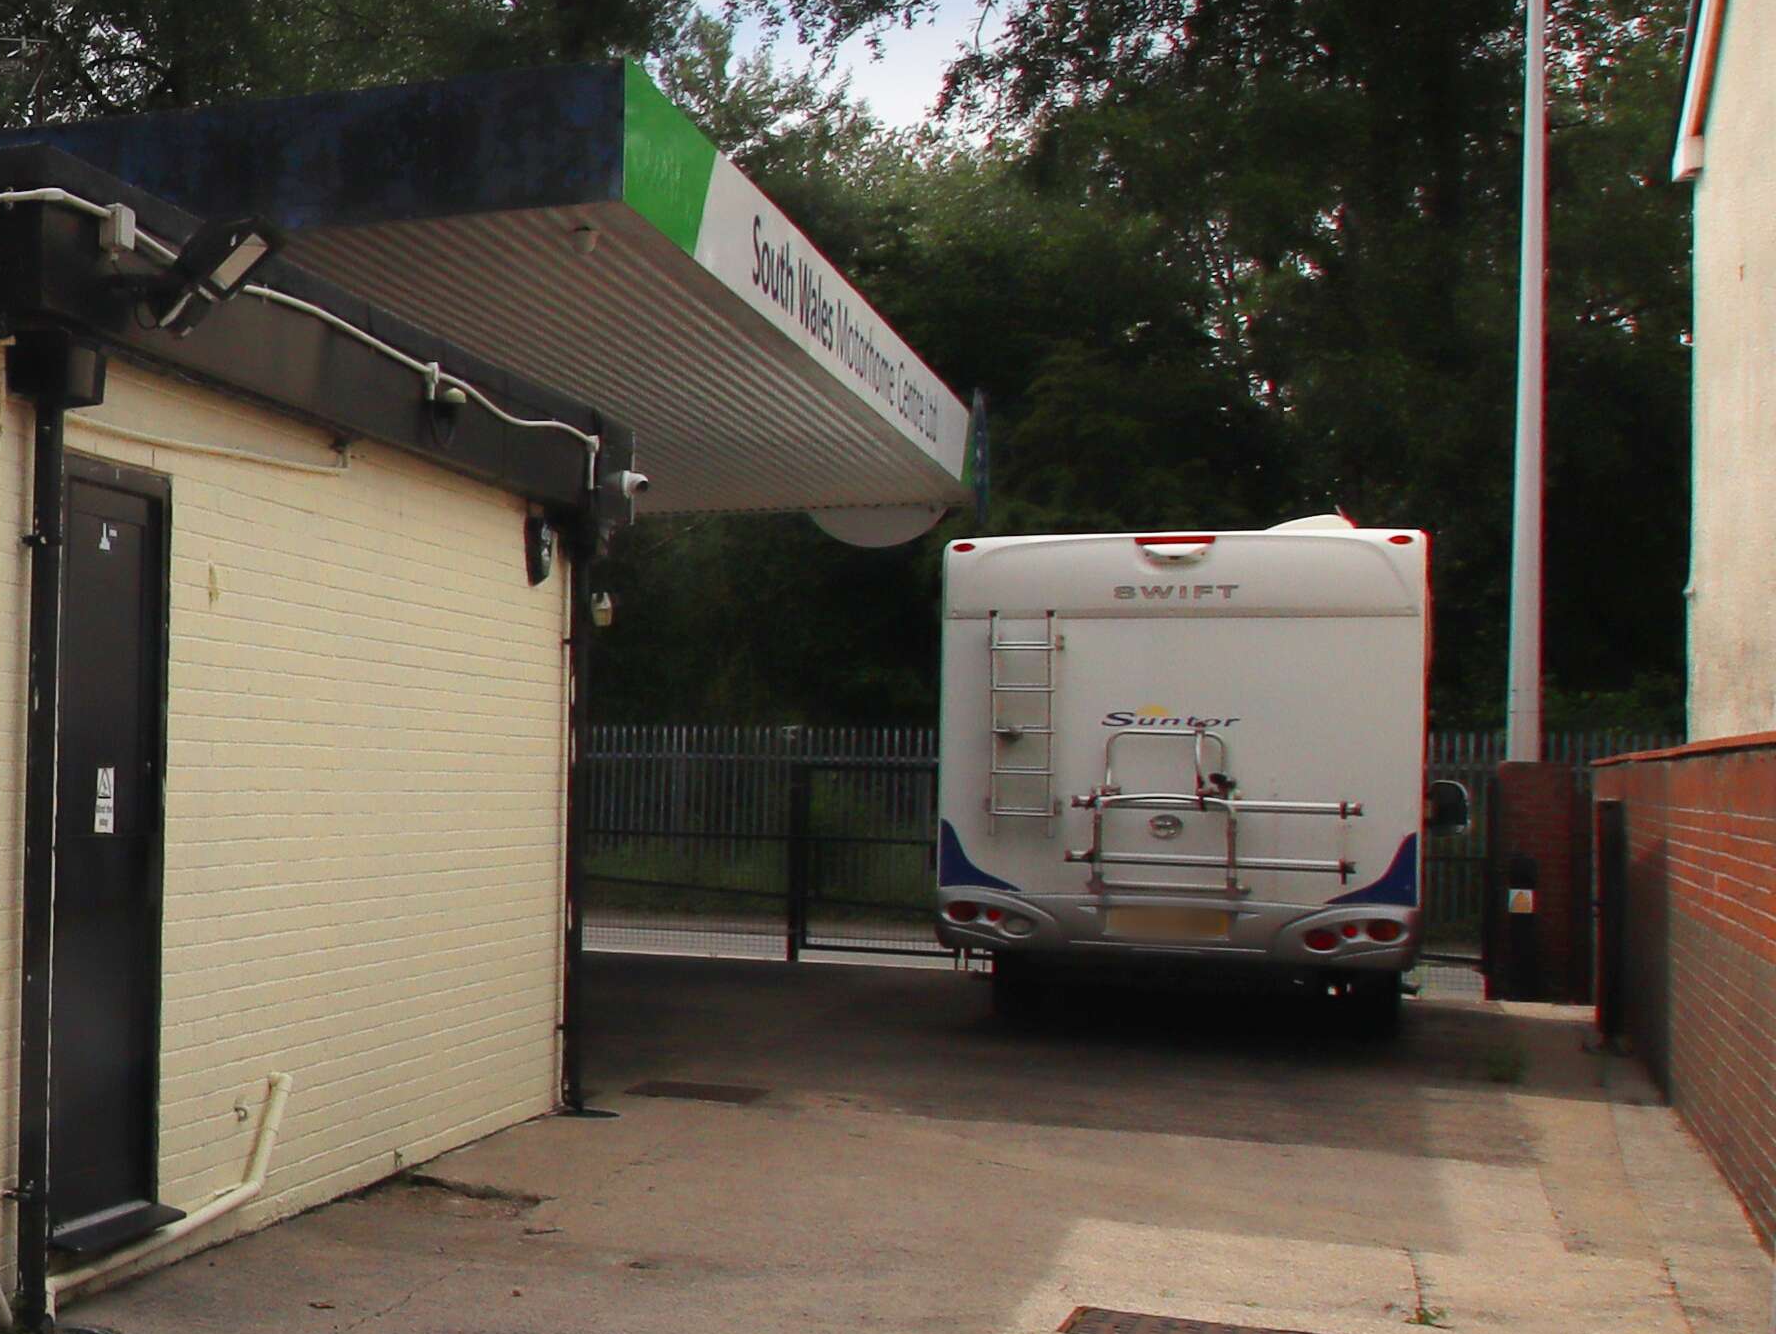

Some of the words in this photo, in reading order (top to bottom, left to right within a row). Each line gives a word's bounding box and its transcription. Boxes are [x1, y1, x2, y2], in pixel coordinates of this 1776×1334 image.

[752, 215, 794, 316] South
[799, 258, 834, 352] Wales
[836, 298, 896, 407] Motorhome
[1113, 584, 1240, 600] SWIFT
[1101, 711, 1241, 728] Suntor
